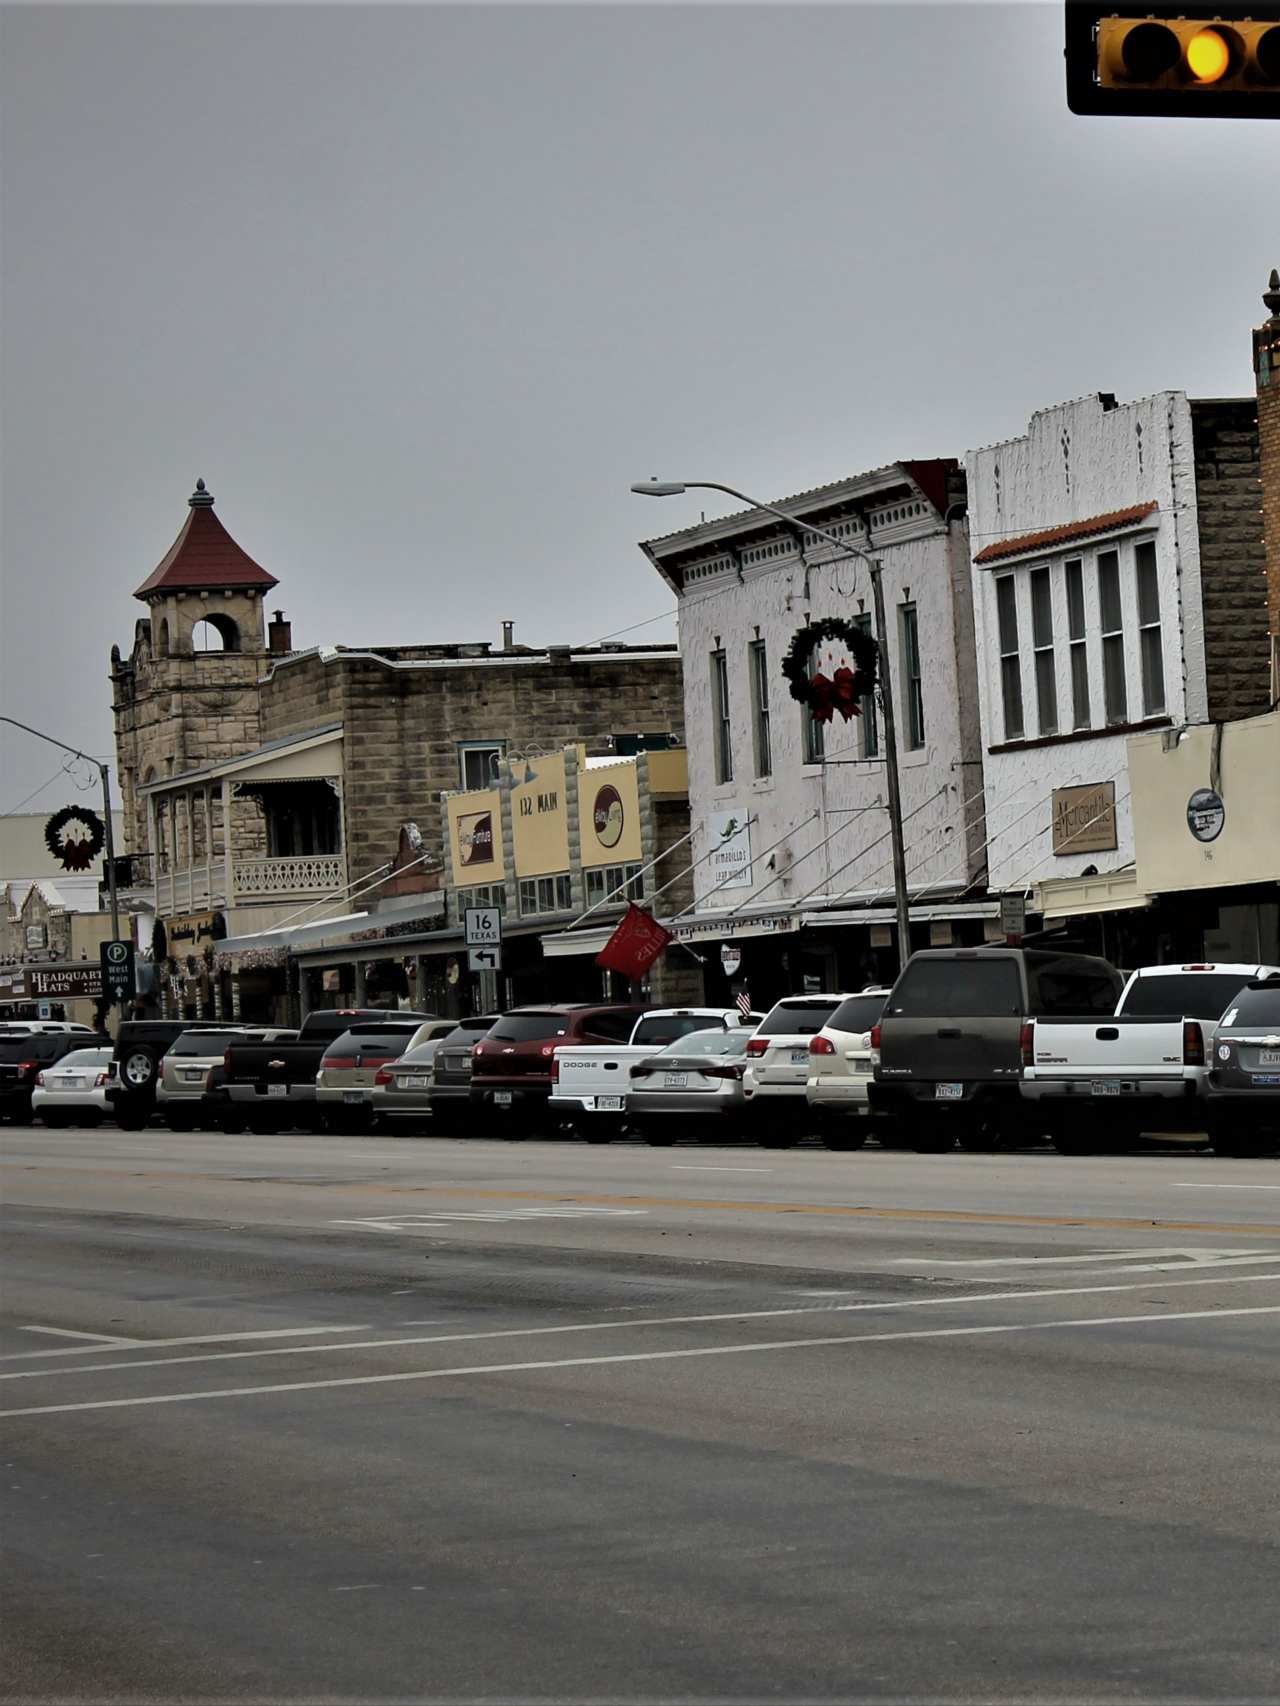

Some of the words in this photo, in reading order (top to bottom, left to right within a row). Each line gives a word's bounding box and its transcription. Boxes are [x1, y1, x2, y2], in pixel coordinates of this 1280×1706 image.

[520, 796, 533, 817] 132
[537, 791, 558, 814] MAIN
[1058, 793, 1111, 838] Mercantile
[475, 914, 492, 930] 16
[470, 931, 497, 940] TEXAS
[108, 964, 129, 974] West
[108, 974, 129, 984] Main
[37, 982, 70, 993] HATS
